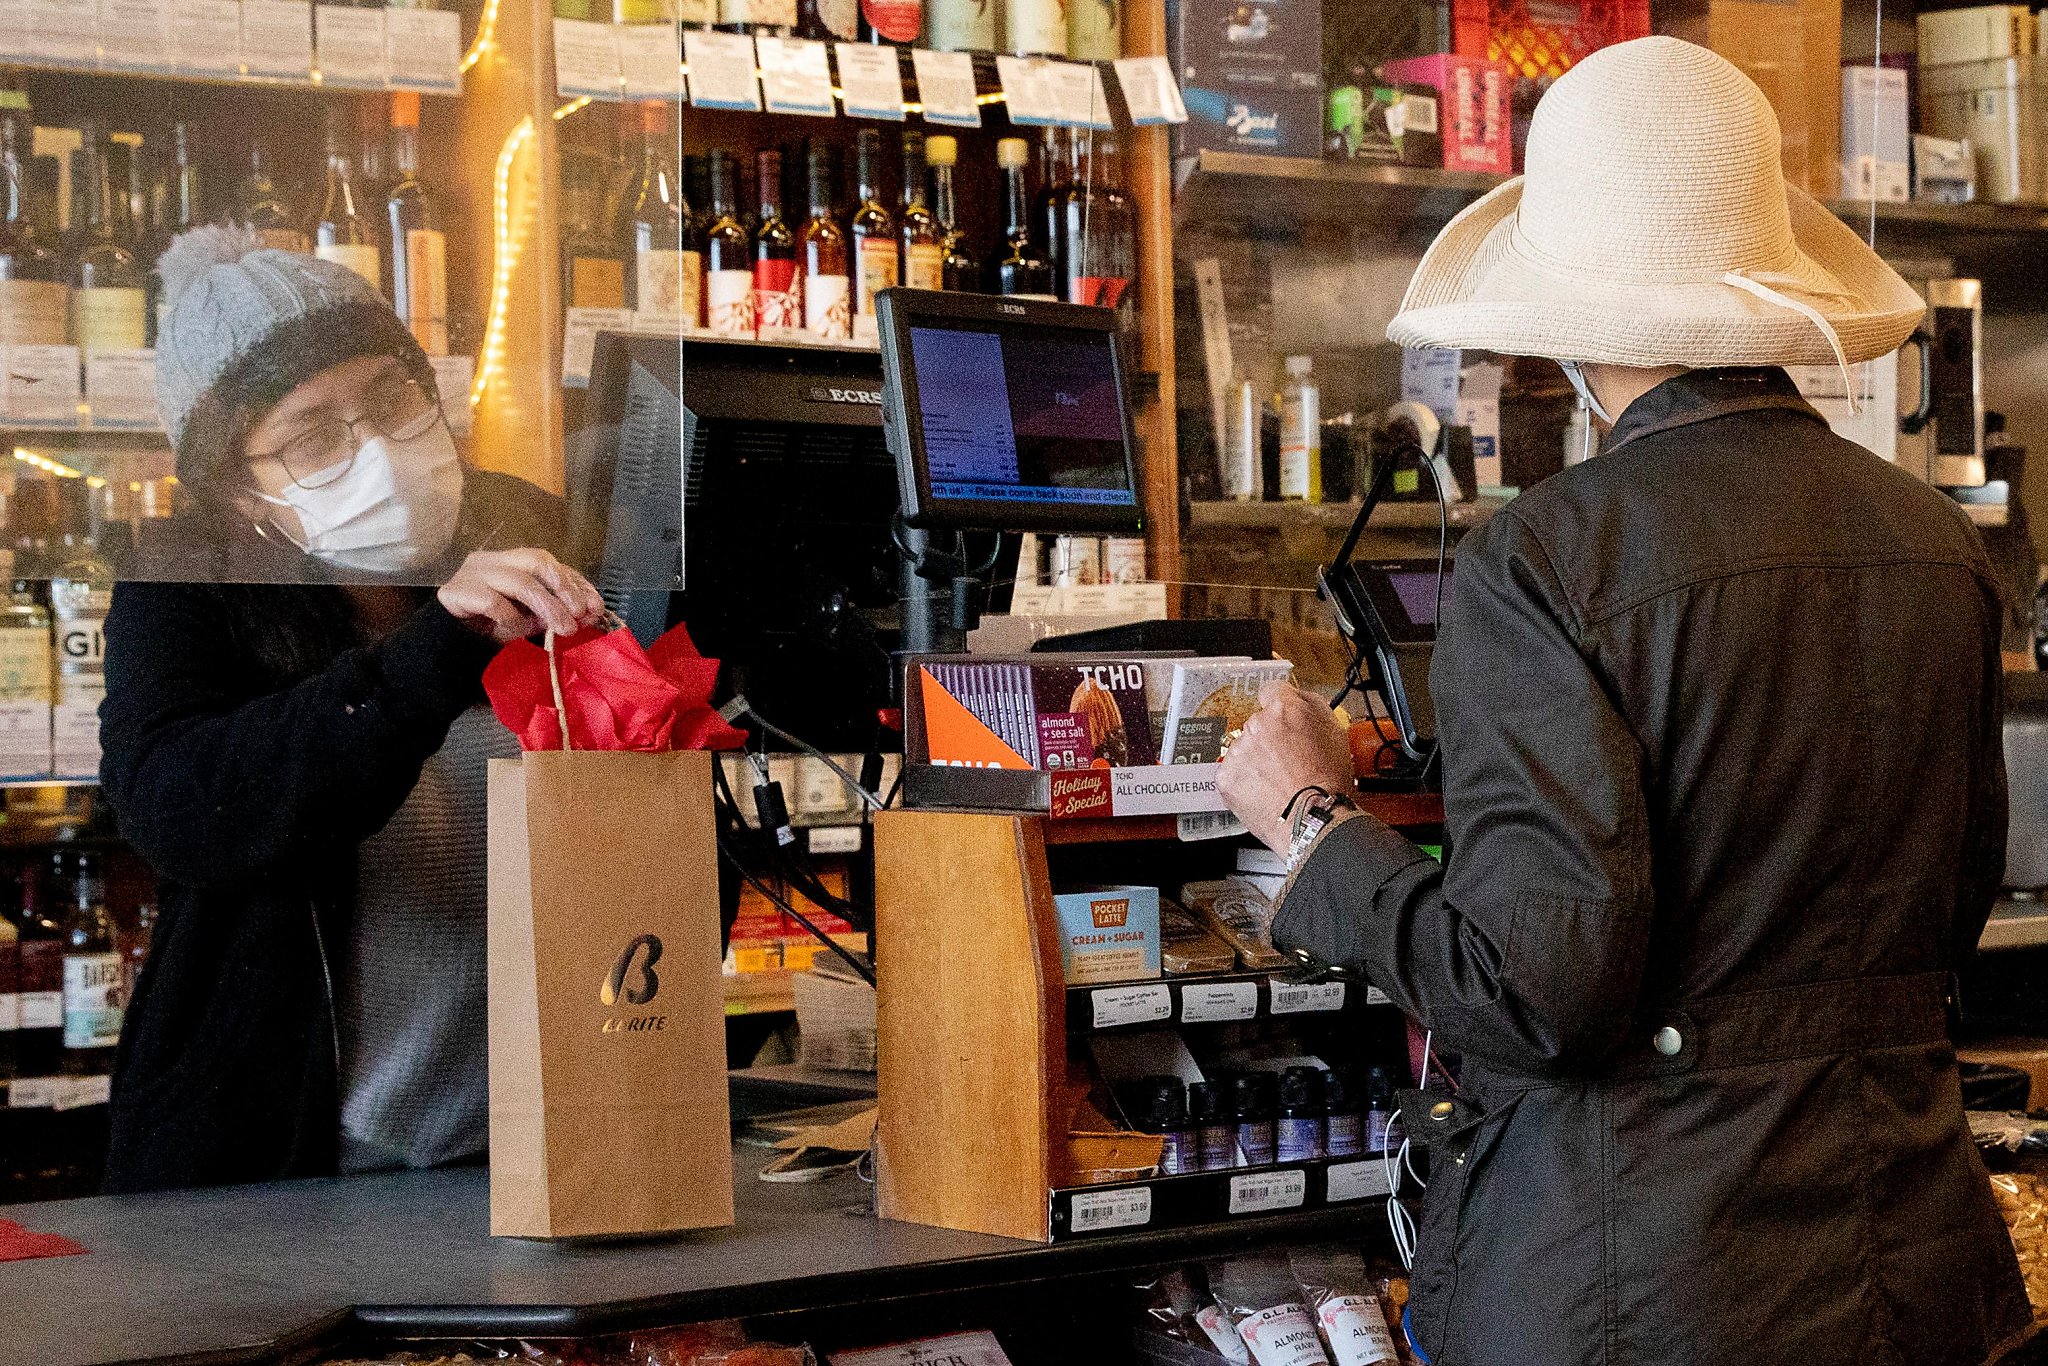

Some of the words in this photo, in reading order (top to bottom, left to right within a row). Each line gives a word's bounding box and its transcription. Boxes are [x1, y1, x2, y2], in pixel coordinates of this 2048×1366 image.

[1003, 304, 1025, 315] ECRS
[829, 388, 882, 405] ECRS
[976, 487, 1007, 498] Please
[1008, 489, 1034, 498] come
[1036, 488, 1058, 499] back
[1060, 490, 1083, 500] soon
[1077, 664, 1143, 691] TCHO
[1041, 716, 1075, 728] almond
[1179, 722, 1213, 735] eggnog
[1051, 729, 1067, 739] sea
[1068, 726, 1085, 738] salt
[1115, 772, 1134, 780] TCHO
[1053, 775, 1103, 798] Holiday
[1116, 785, 1133, 796] ALL
[1135, 782, 1191, 794] CHOCOLATE
[1192, 781, 1216, 792] BARS
[1065, 791, 1108, 814] Special
[1094, 903, 1126, 914] POCKET
[1099, 914, 1122, 924] LATTE
[1072, 934, 1106, 945] CREAM
[1114, 931, 1145, 943] SUGAR
[1294, 1341, 1315, 1352] RAW
